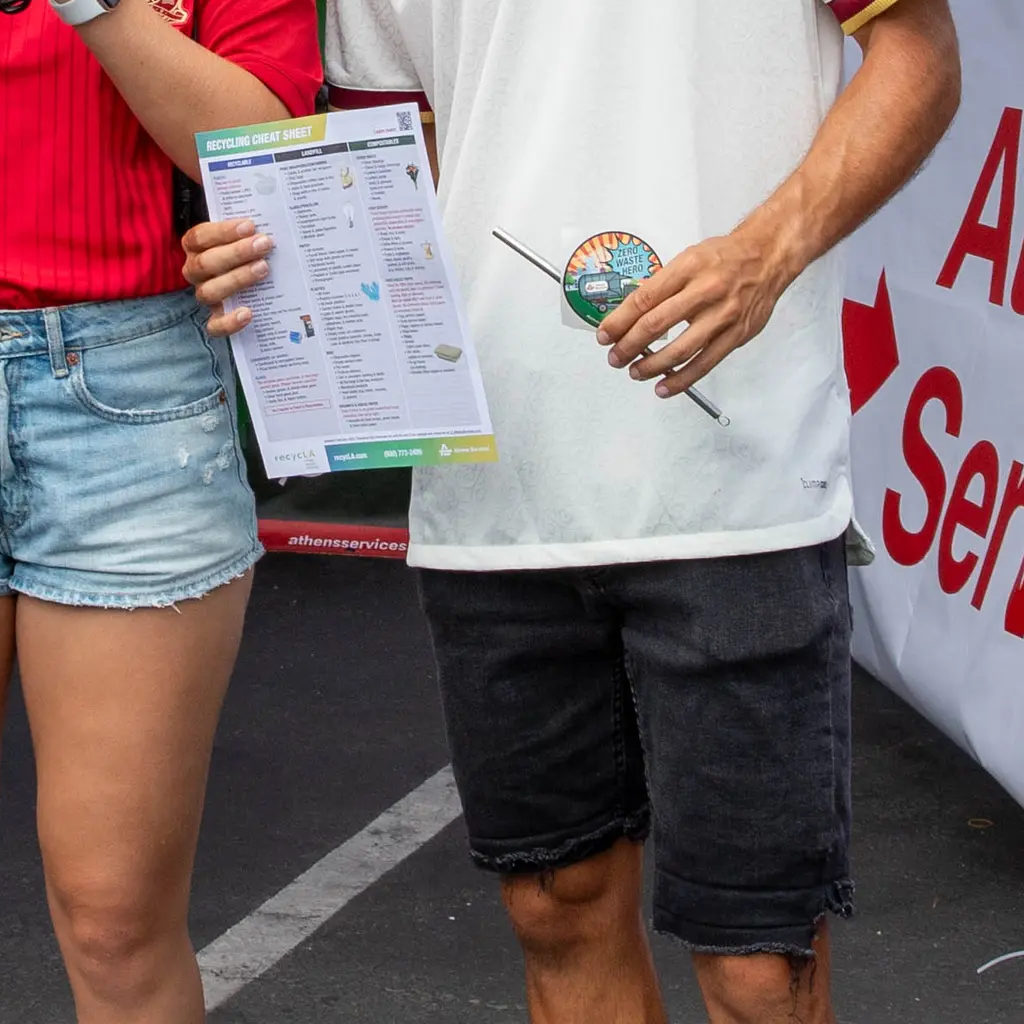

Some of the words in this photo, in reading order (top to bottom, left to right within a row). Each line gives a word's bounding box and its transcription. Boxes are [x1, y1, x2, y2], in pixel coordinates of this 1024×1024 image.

[206, 135, 251, 151] RECYCLING
[252, 131, 281, 145] CHEAT
[282, 126, 313, 141] SHEET
[617, 247, 638, 257] ZERO
[616, 255, 644, 267] WASTE
[622, 264, 644, 276] HERO
[288, 535, 408, 551] athensservices
